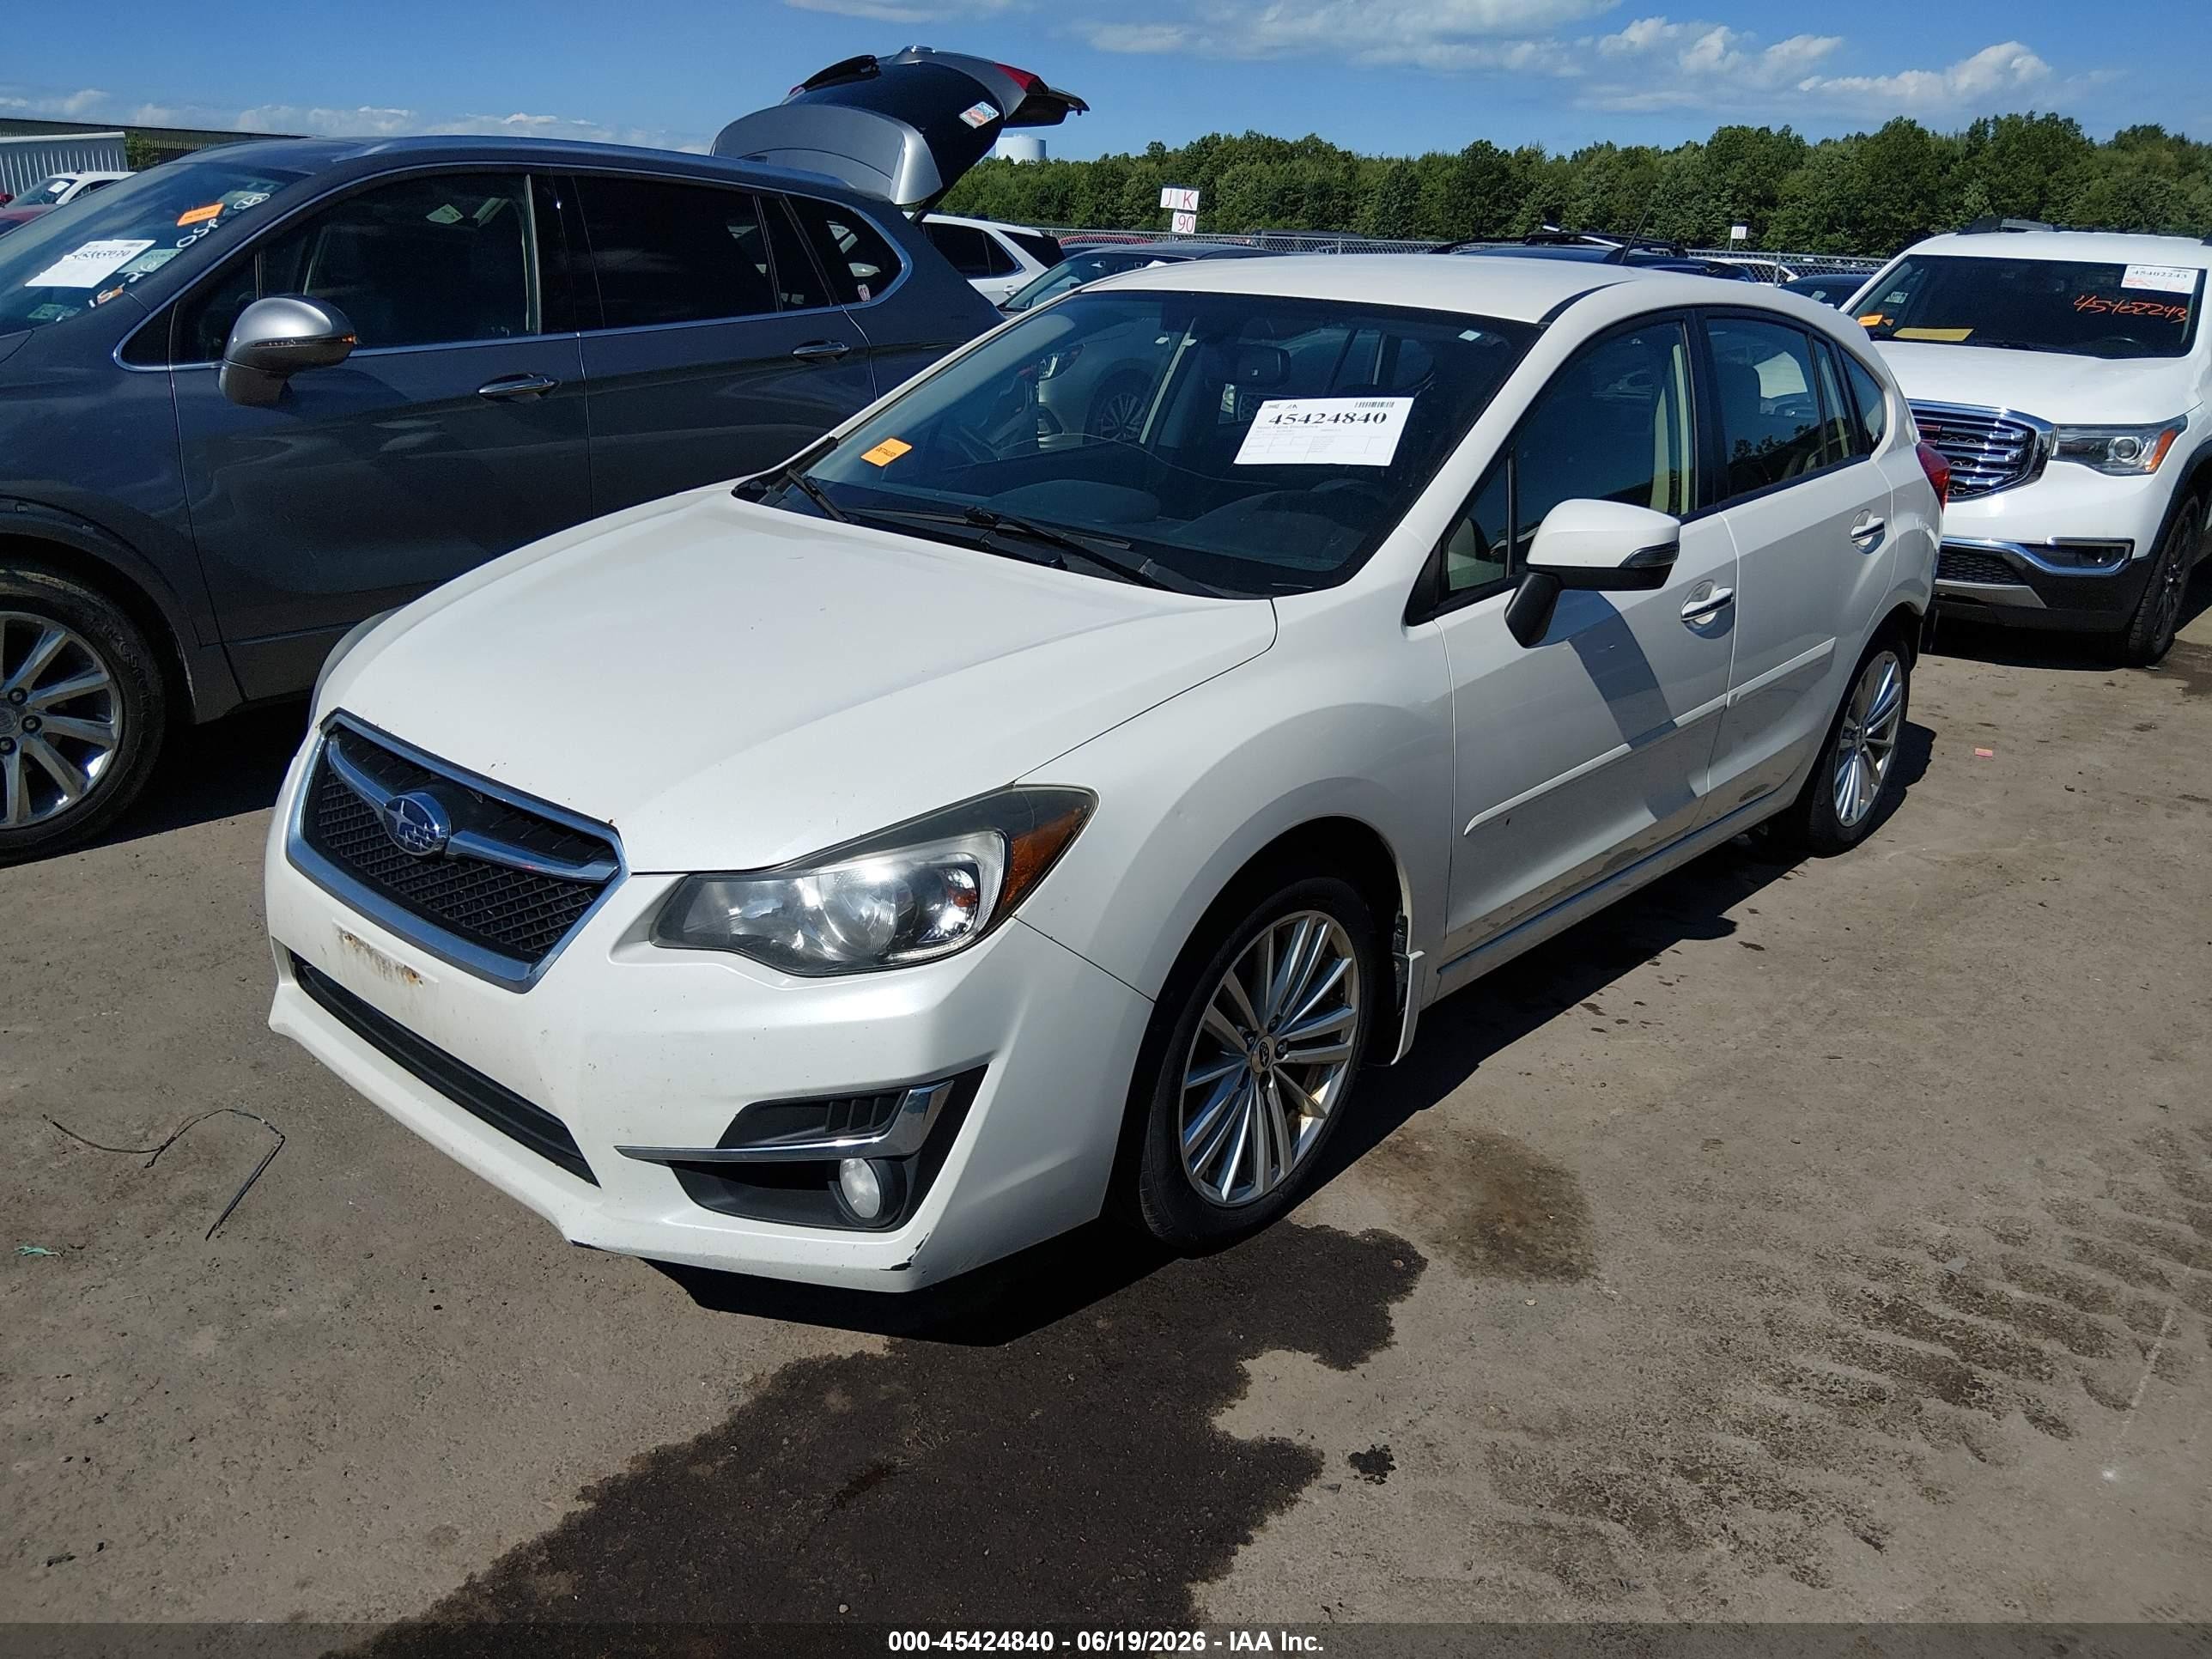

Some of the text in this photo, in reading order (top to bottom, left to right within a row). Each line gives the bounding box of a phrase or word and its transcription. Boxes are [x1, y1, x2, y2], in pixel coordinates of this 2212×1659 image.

[1165, 190, 1194, 209] J K
[1178, 215, 1194, 233] 90
[2074, 295, 2188, 324] 45402243
[1269, 412, 1387, 425] 45424840
